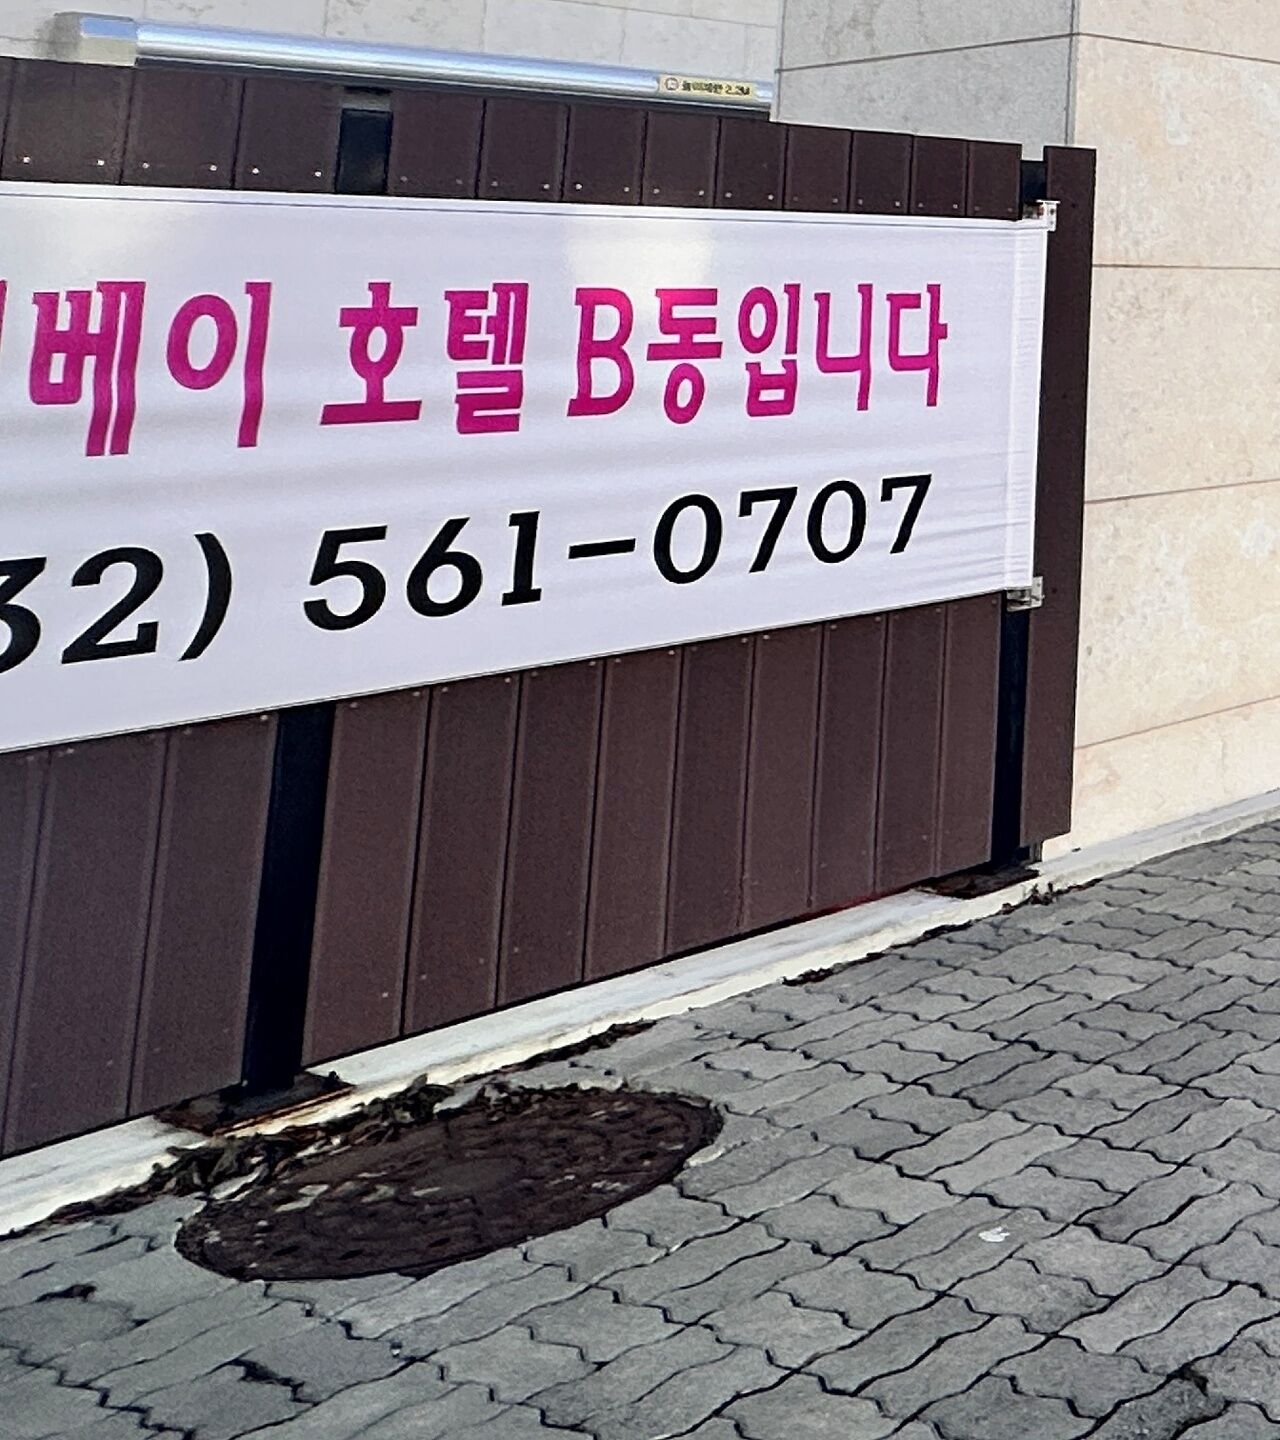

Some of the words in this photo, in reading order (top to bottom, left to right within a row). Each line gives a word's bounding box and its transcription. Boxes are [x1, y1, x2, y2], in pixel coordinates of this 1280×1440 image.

[0, 280, 272, 457] 베이
[321, 280, 528, 435] 호텔
[567, 282, 948, 424] B동입니다
[303, 473, 932, 631] 561-0707
